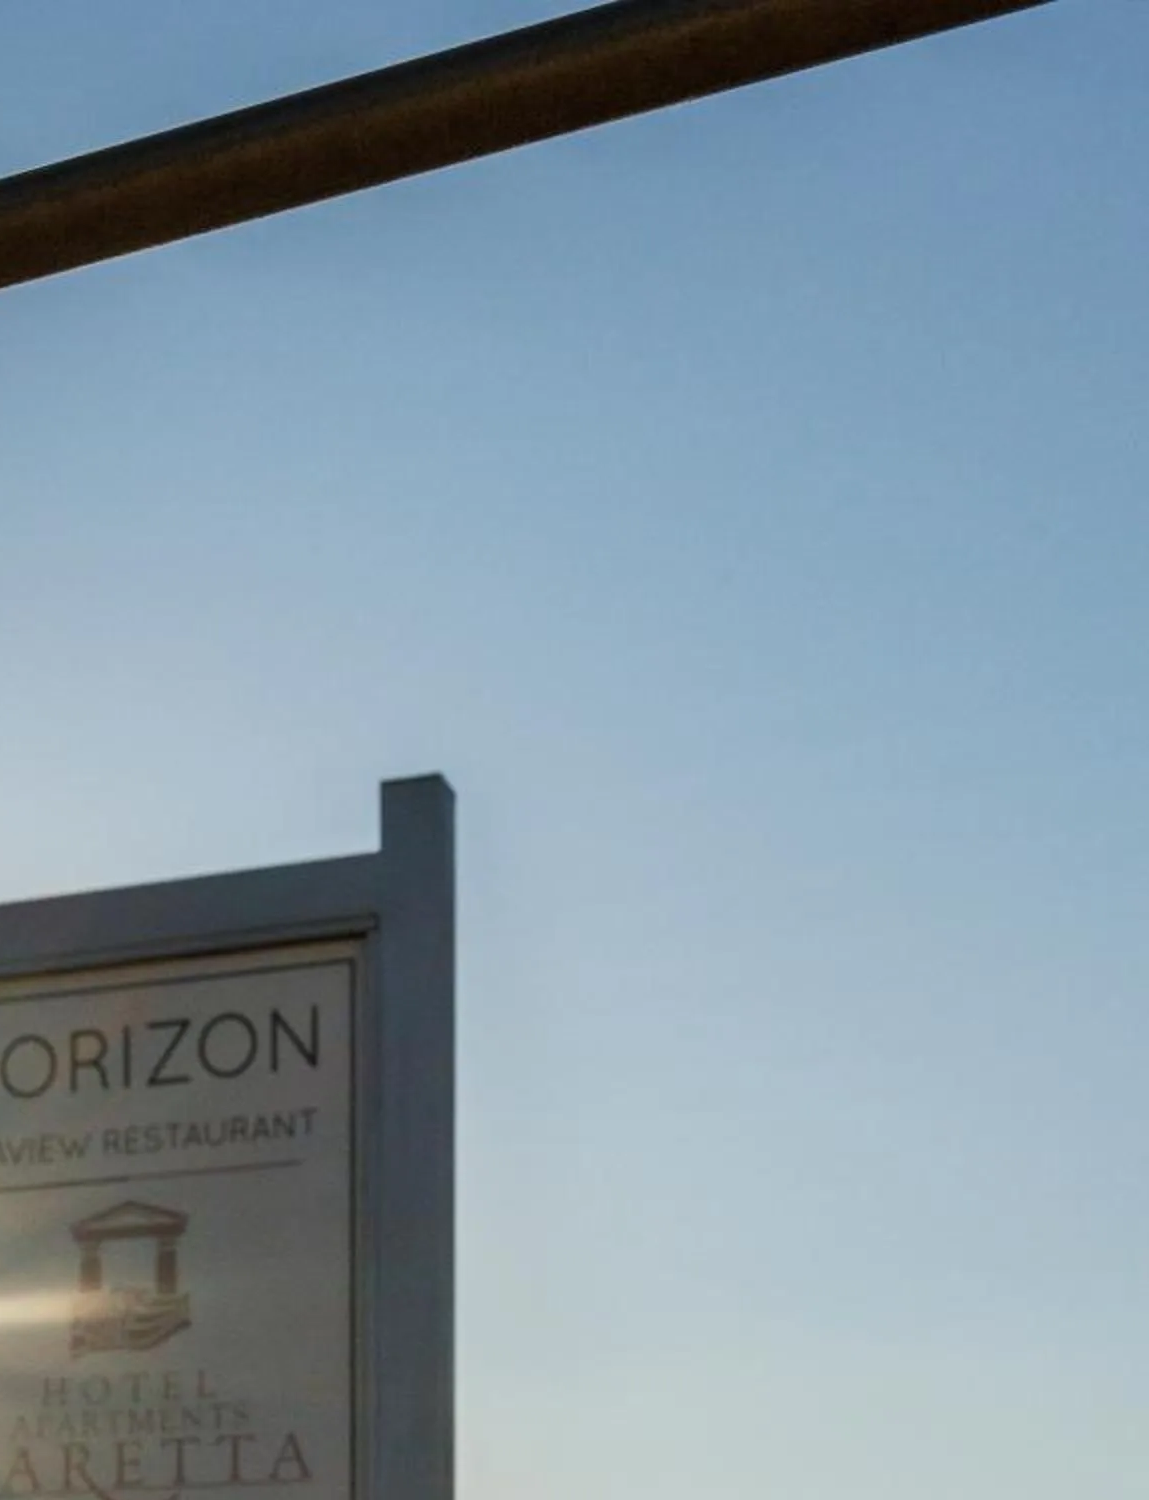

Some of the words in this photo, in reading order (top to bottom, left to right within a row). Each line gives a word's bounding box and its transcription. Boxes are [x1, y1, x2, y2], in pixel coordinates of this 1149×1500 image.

[102, 1107, 318, 1155] RESTAURANT
[42, 1369, 218, 1405] HOTEL
[11, 1403, 250, 1441] APARTMENTS
